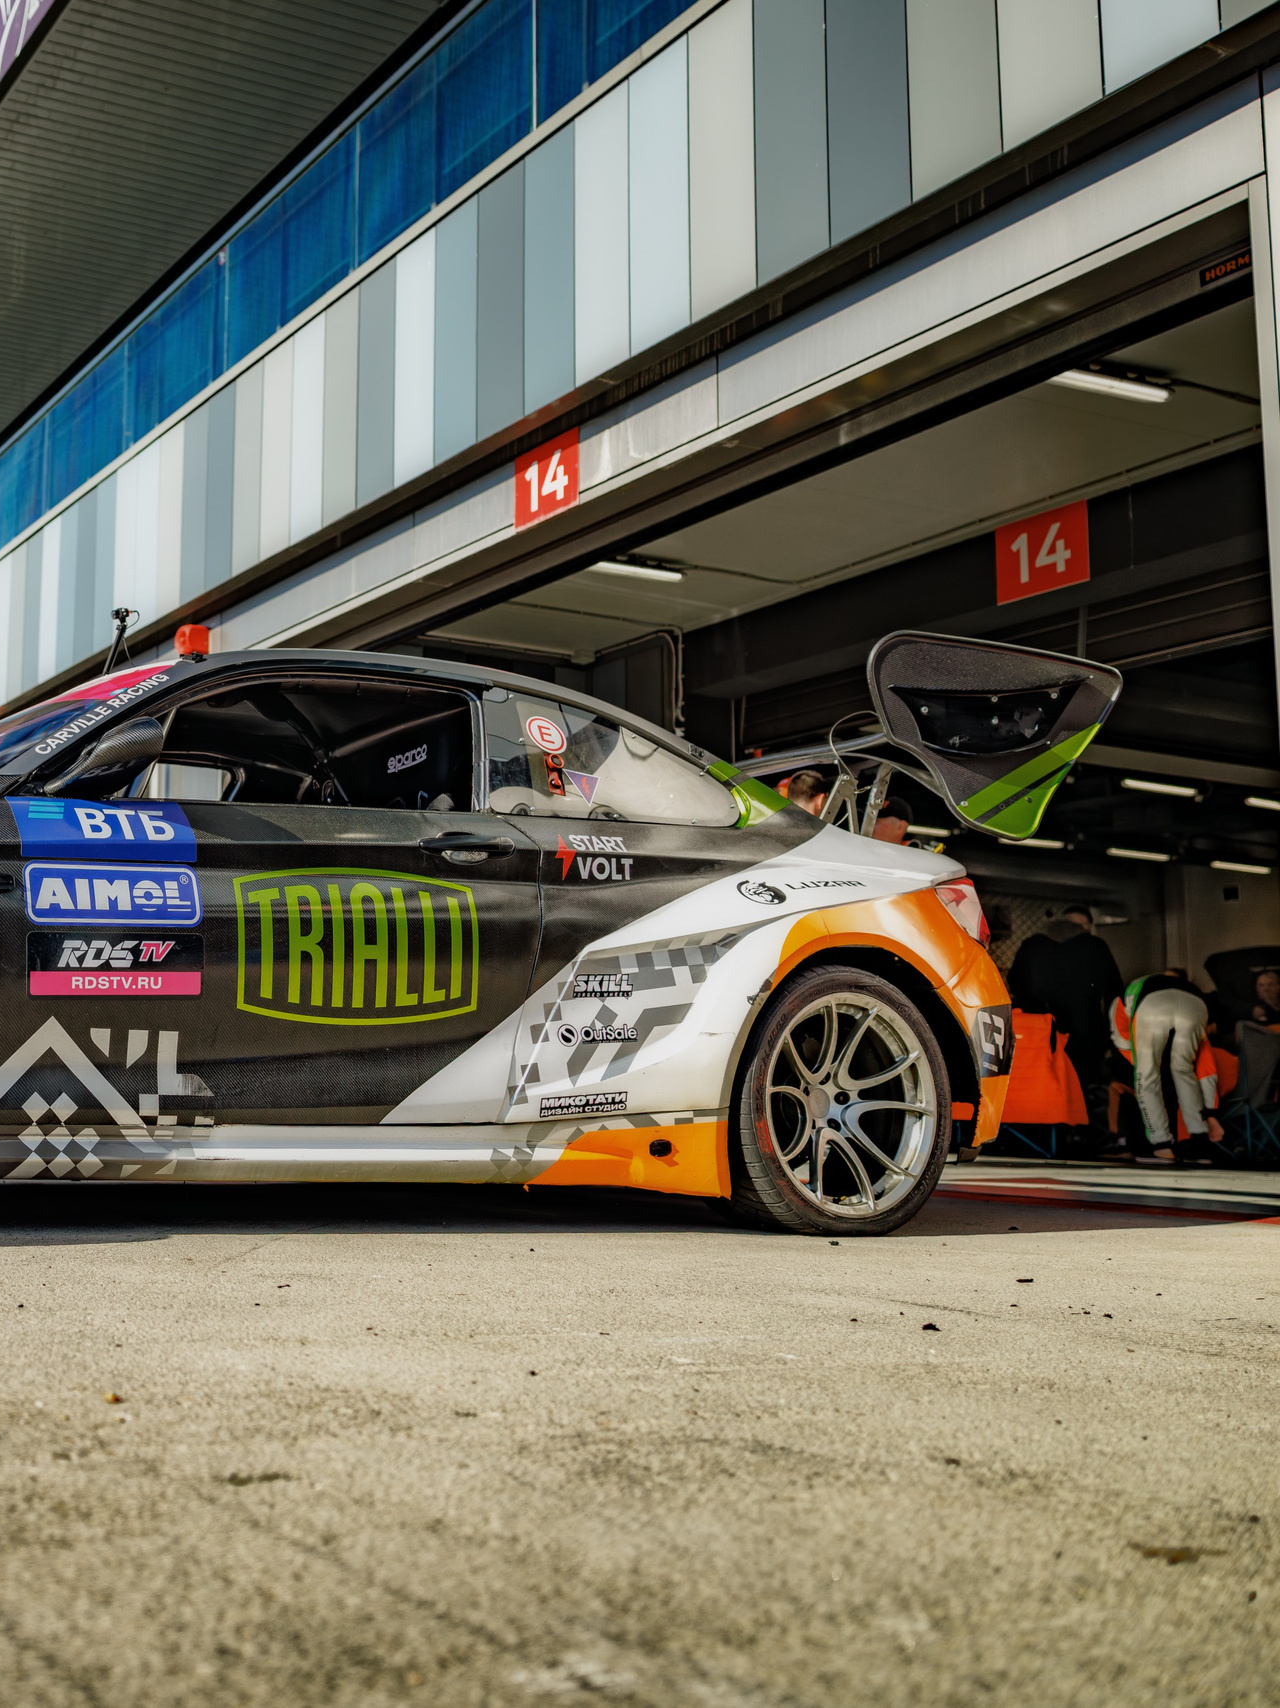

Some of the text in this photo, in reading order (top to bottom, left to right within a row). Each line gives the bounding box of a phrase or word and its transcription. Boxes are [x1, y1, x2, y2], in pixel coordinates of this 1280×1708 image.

[523, 449, 569, 512] 14
[1010, 522, 1071, 584] 14
[35, 673, 170, 755] CARVILLE RACING
[537, 724, 555, 745] E
[74, 807, 175, 841] ВТБ
[569, 834, 628, 852] START
[577, 857, 634, 881] VOLT
[248, 882, 463, 1008] TRIALLI
[71, 976, 162, 990] RDSTV.RU
[574, 974, 633, 992] SKILL
[581, 1024, 638, 1041] OutSale
[540, 1103, 626, 1117] ДИЗАЙН СТУДИО
[541, 1092, 627, 1108] МИКОТАТИ
